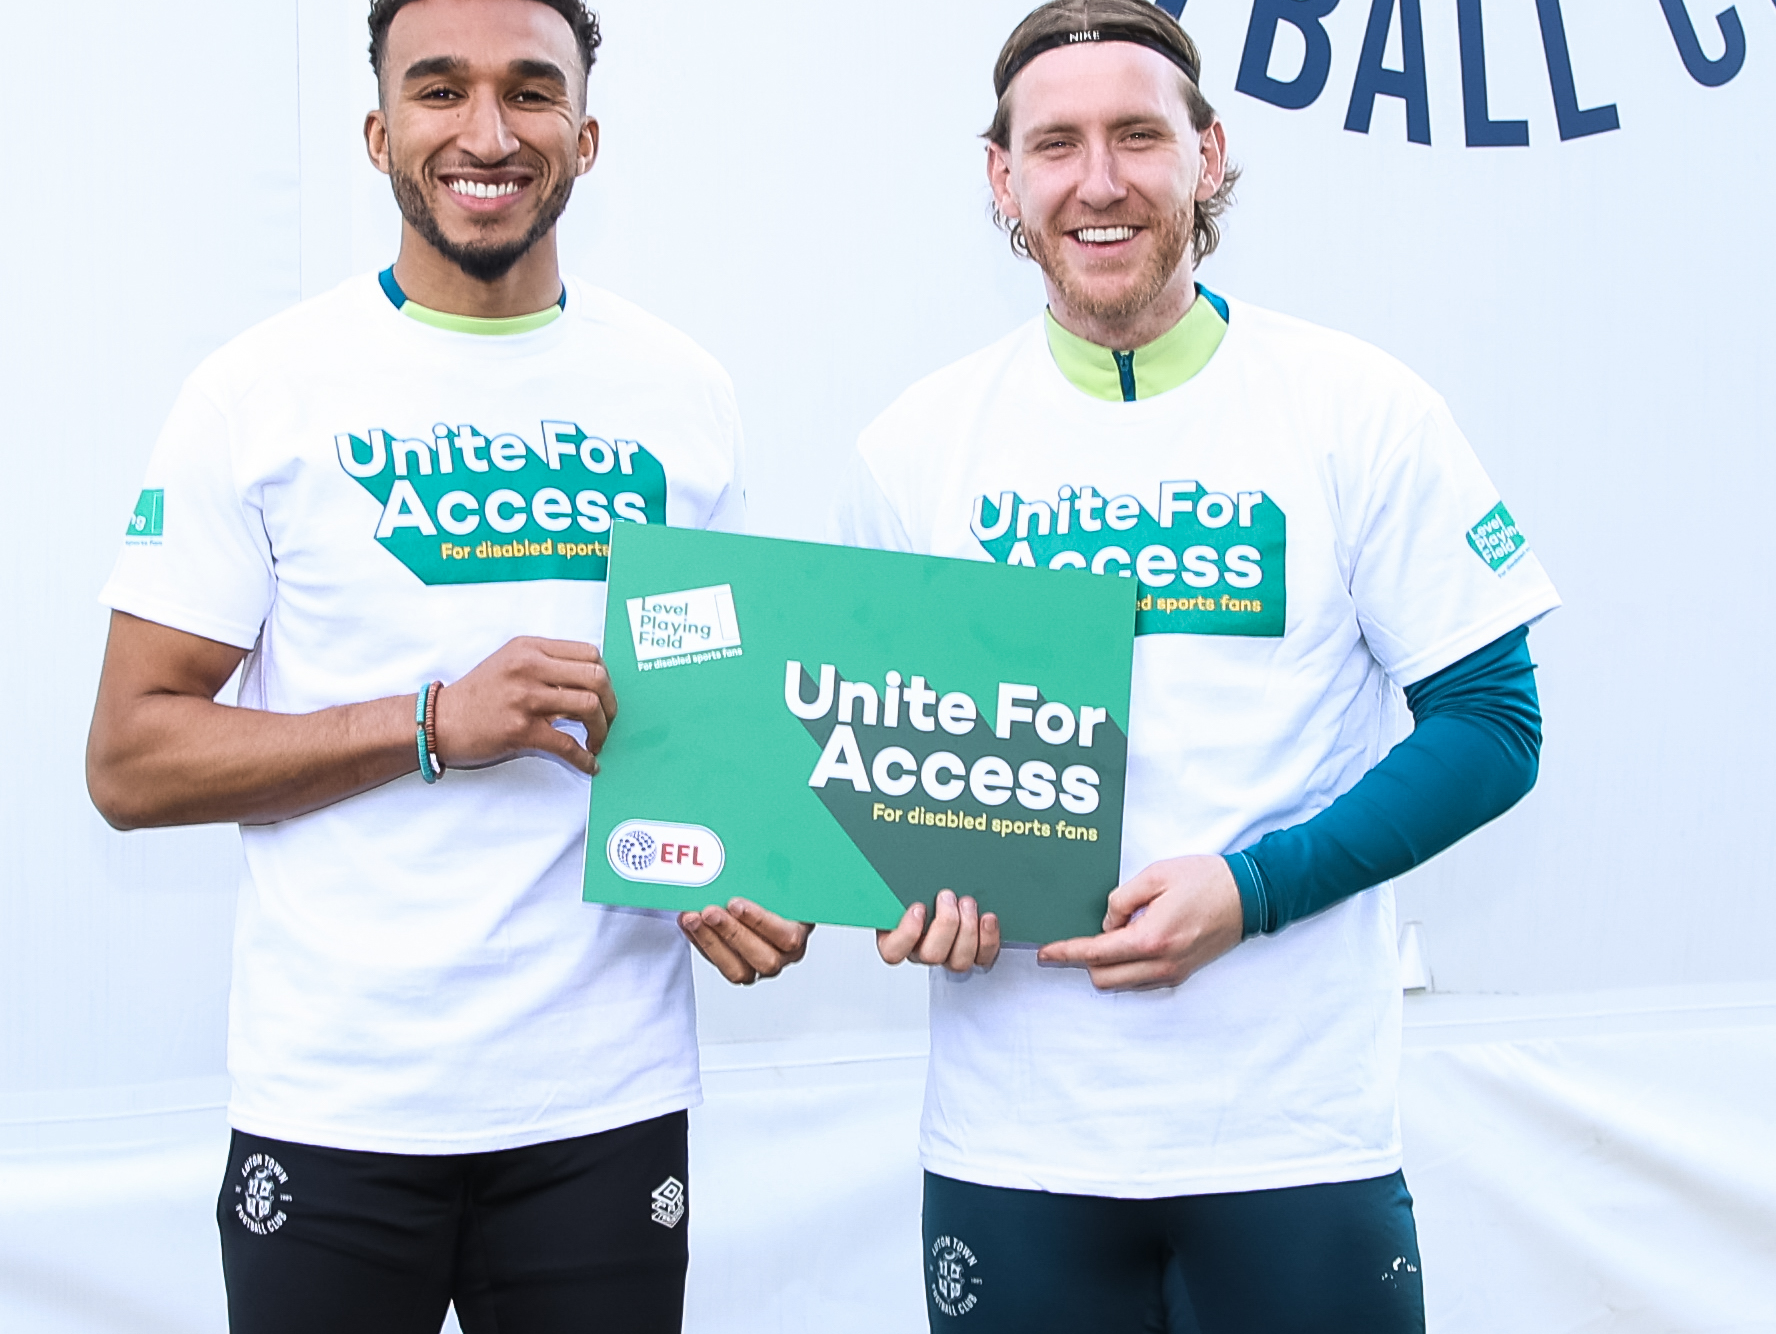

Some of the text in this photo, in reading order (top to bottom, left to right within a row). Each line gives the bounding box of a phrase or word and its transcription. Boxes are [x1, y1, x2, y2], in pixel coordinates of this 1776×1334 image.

[1069, 30, 1100, 42] NIKE
[335, 419, 639, 478] Unite For
[375, 479, 648, 538] Access
[970, 480, 1263, 541] Unite For
[440, 542, 471, 560] For
[475, 538, 553, 559] disabled
[1475, 524, 1520, 549] Playin
[1482, 537, 1516, 563] Field
[641, 597, 688, 616] Level
[1156, 596, 1216, 613] sports
[1220, 594, 1263, 613] fans
[640, 614, 711, 639] Playing
[639, 631, 683, 649] Field
[654, 653, 691, 670] disabled
[692, 650, 721, 665] sports
[723, 647, 743, 659] fans
[784, 659, 1107, 748] Unite For
[808, 723, 1100, 815] Access
[872, 802, 1099, 842] For disabled sports fans
[661, 843, 704, 866] EFL
[242, 1153, 289, 1184] LUTON TOWN
[236, 1203, 287, 1235] FOOTBALL CLUB
[953, 1237, 978, 1267] TOWN
[958, 1293, 977, 1315] CLUB
